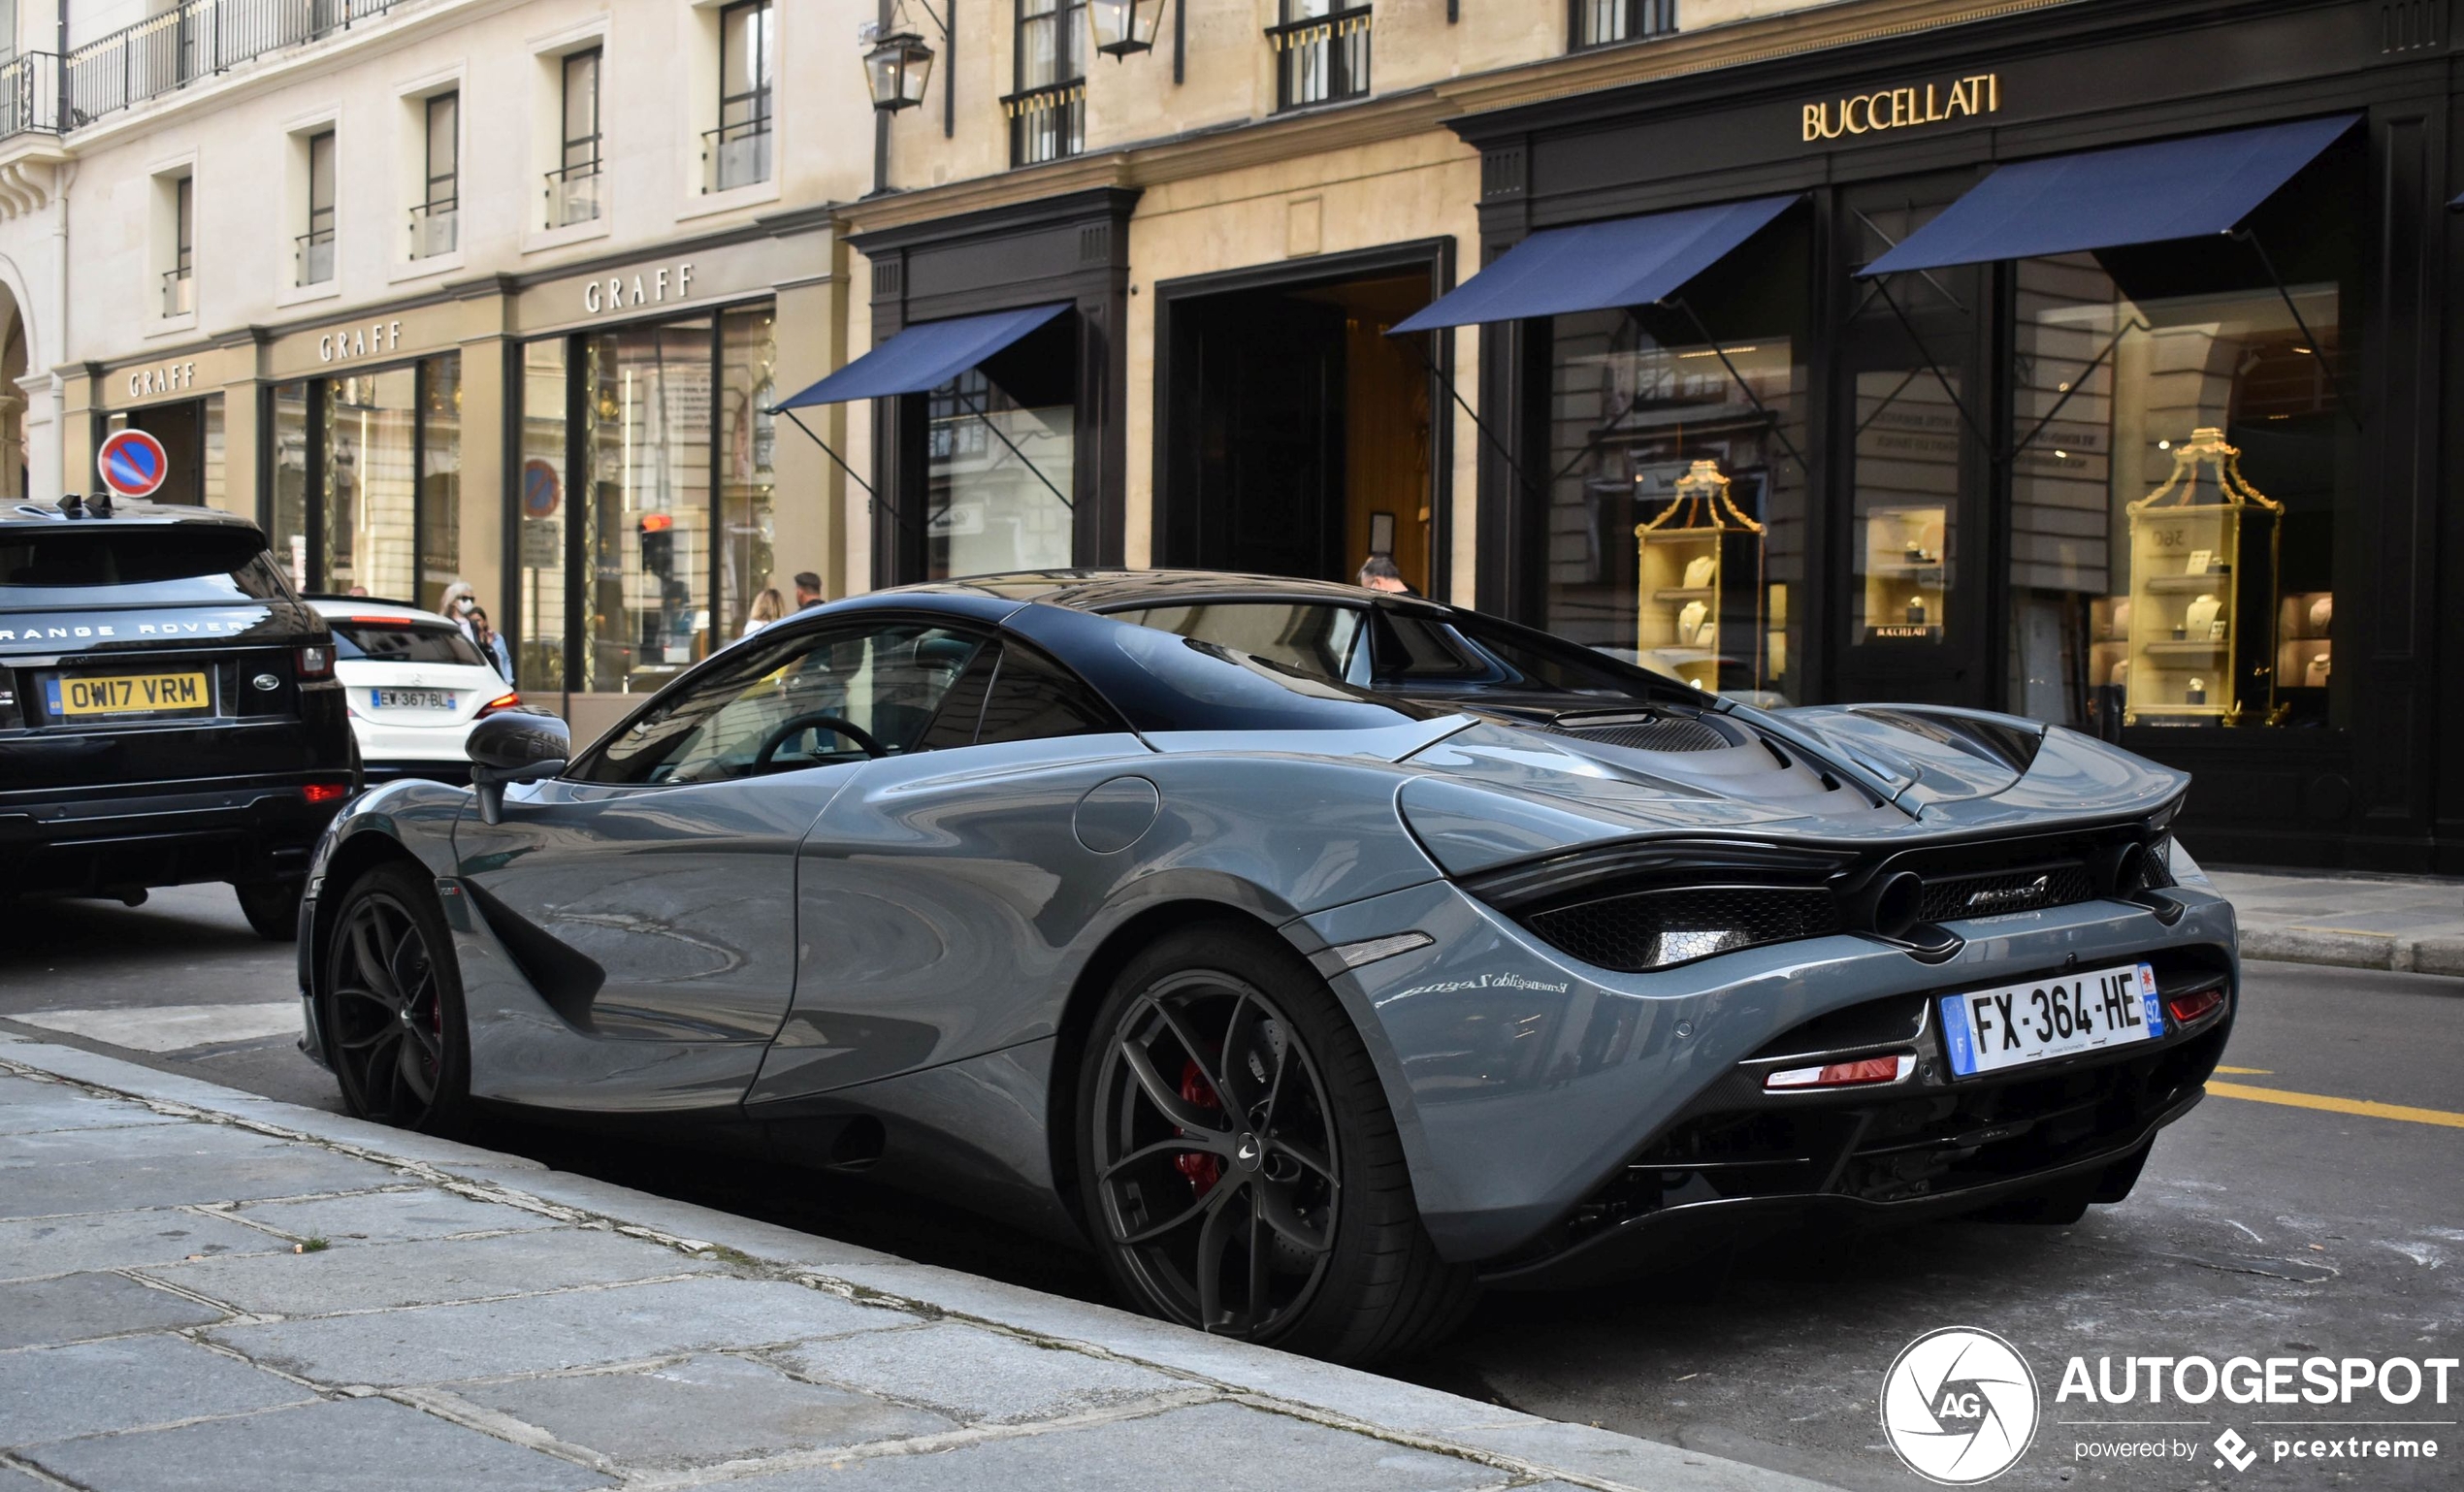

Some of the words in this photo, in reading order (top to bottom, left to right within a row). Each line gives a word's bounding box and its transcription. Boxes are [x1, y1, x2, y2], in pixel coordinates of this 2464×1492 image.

[1802, 73, 1996, 142] BUCCELLATI
[584, 263, 693, 313] GRAFF
[319, 321, 403, 362] GRAFF
[128, 362, 195, 398] GRAFF
[0, 626, 115, 640] RANGE
[138, 621, 243, 634] ROVER
[70, 680, 133, 708] OW17
[142, 677, 197, 705] VRM
[1972, 973, 2141, 1054] FX-364-HE
[2145, 998, 2162, 1024] 92
[1956, 1037, 1964, 1054] F
